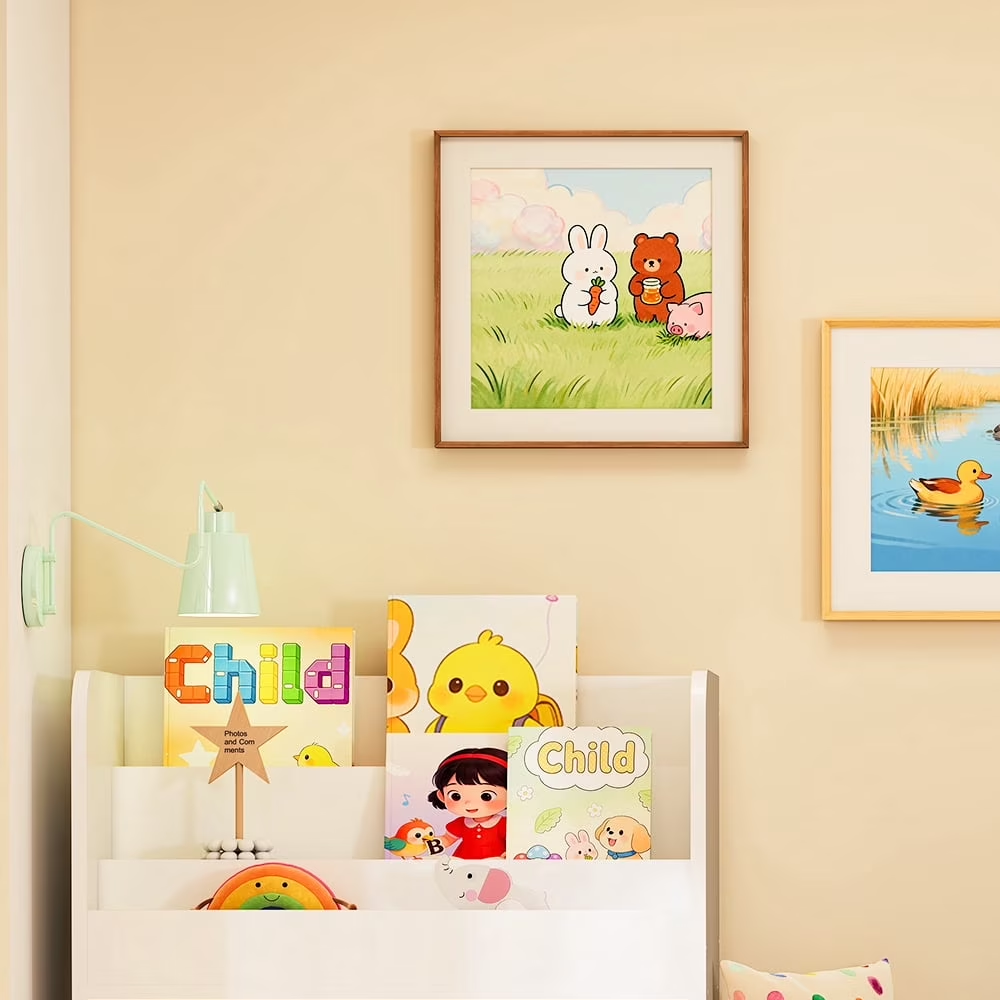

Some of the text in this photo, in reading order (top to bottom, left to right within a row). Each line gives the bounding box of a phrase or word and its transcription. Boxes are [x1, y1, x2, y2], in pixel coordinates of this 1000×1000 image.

[164, 643, 350, 704] Child
[537, 740, 636, 775] Child
[427, 839, 444, 855] B
